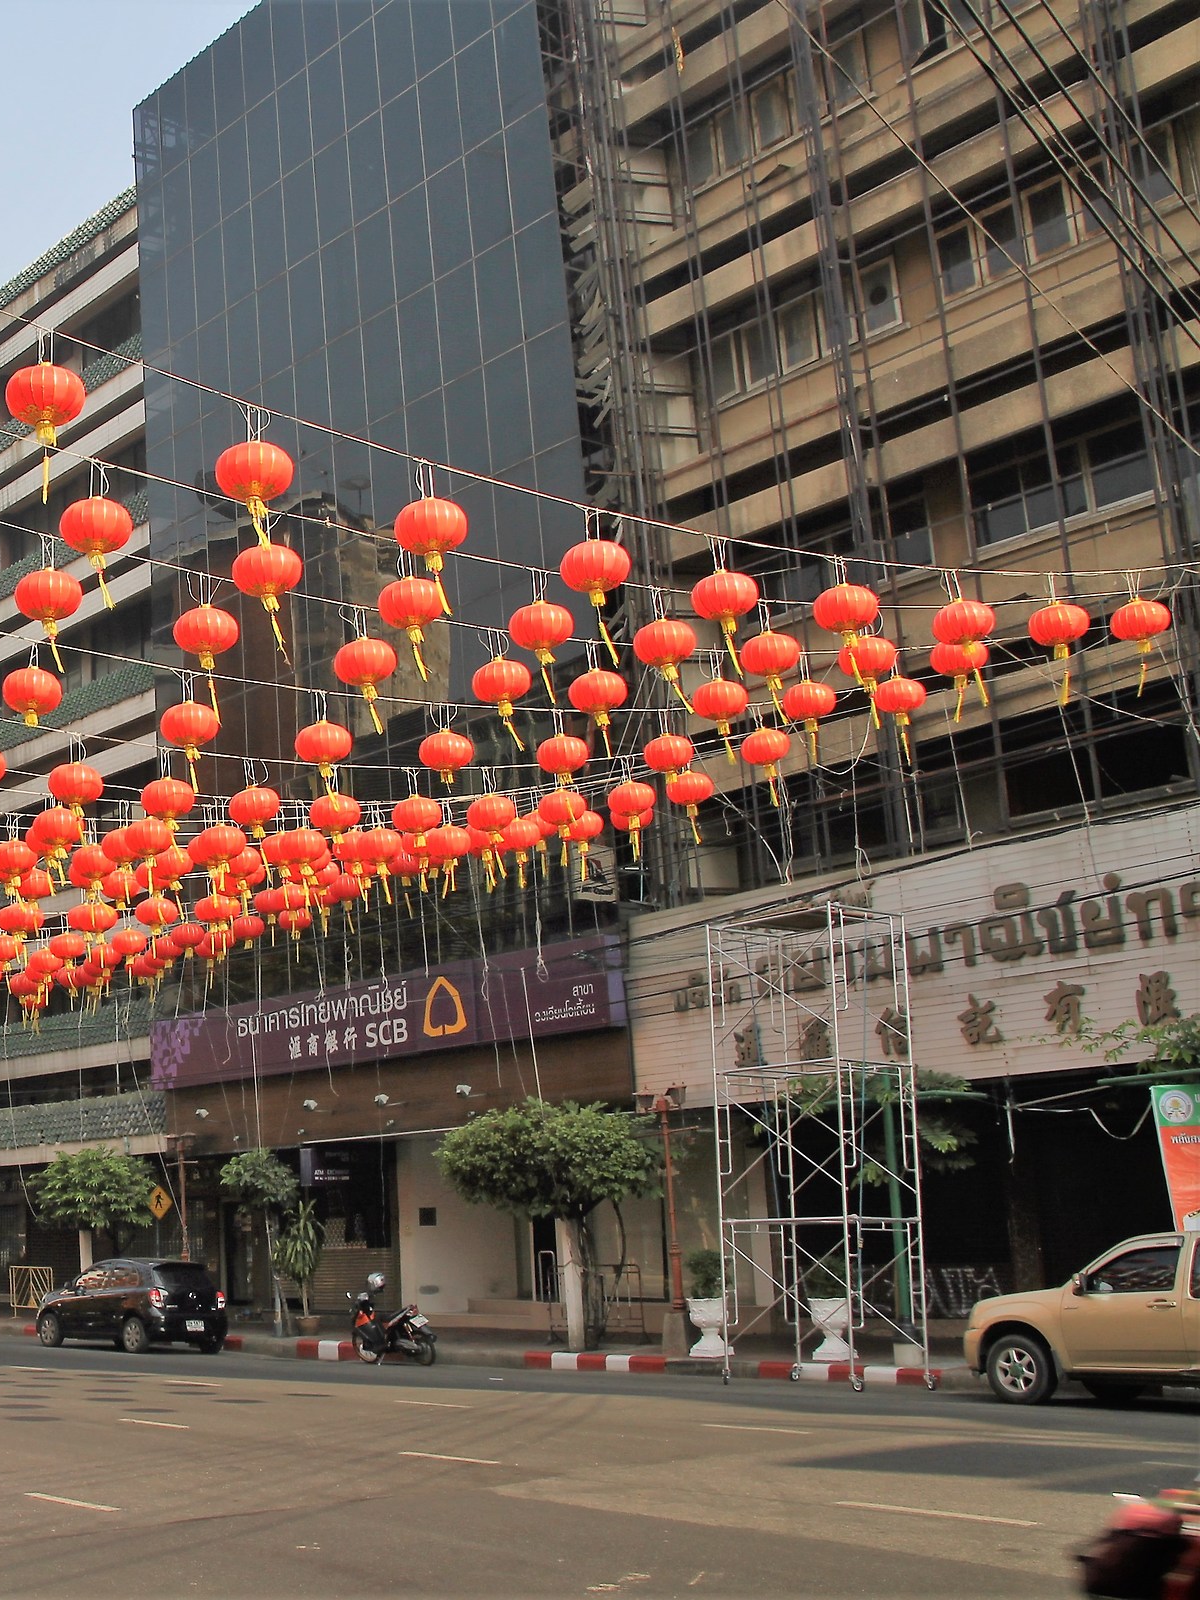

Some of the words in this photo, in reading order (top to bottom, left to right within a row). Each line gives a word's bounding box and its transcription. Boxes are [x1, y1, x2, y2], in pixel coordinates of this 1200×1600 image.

[572, 983, 594, 997] สาขา
[237, 980, 408, 1038] ธนาคารไทยพาณิชย์
[365, 1017, 408, 1048] SCB
